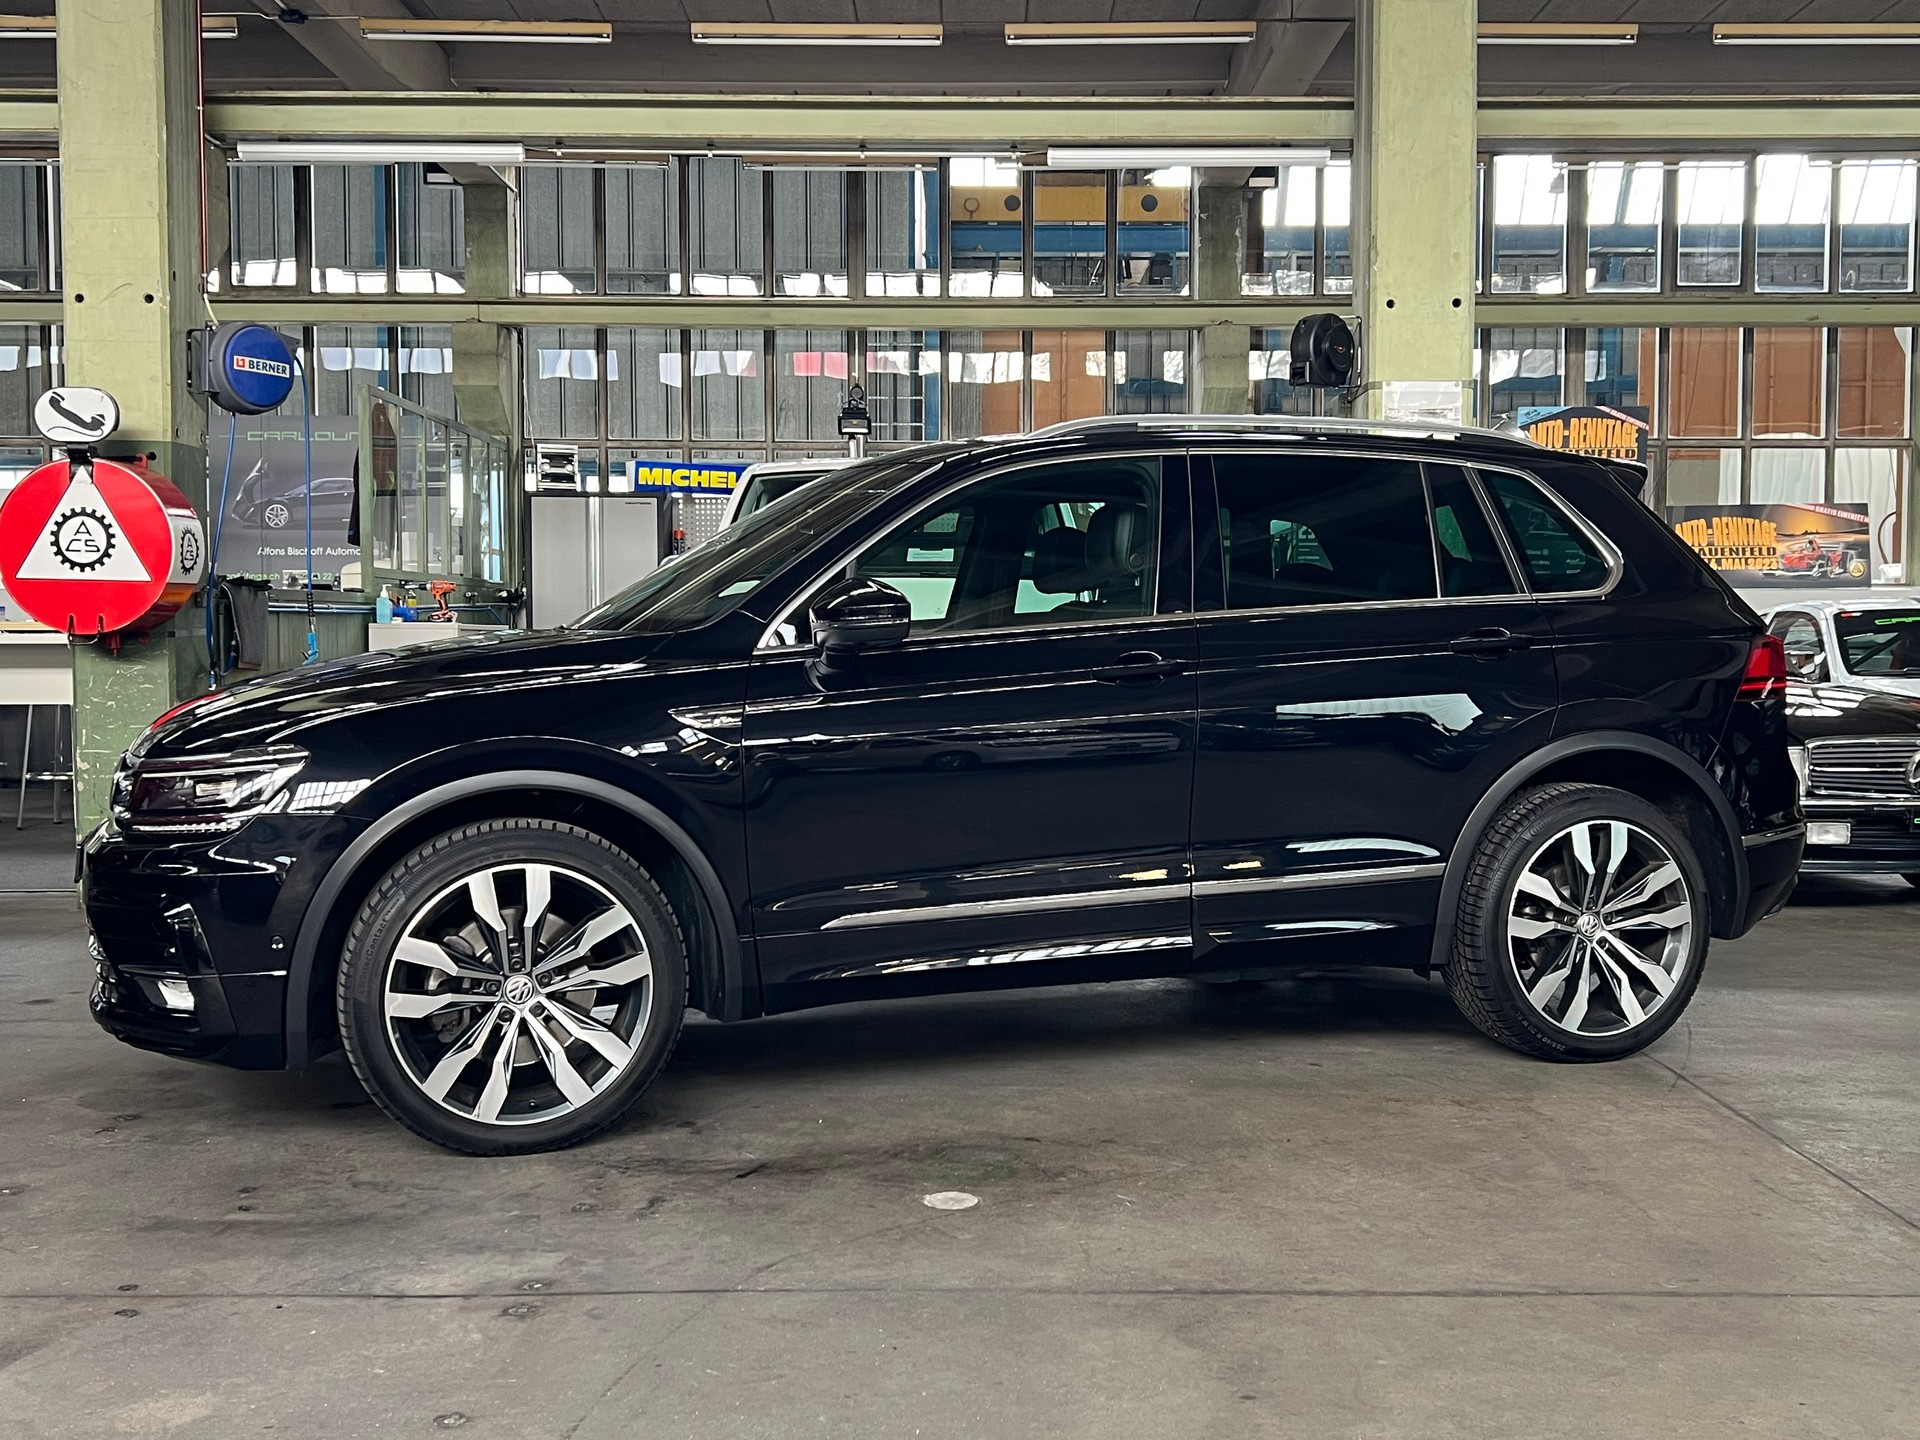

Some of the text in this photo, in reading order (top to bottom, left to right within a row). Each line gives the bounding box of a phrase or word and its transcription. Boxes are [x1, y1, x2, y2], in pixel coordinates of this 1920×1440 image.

[248, 359, 287, 375] BERNER
[1675, 517, 1777, 547] AUTO-RENNTAGE
[257, 547, 285, 556] Alfons
